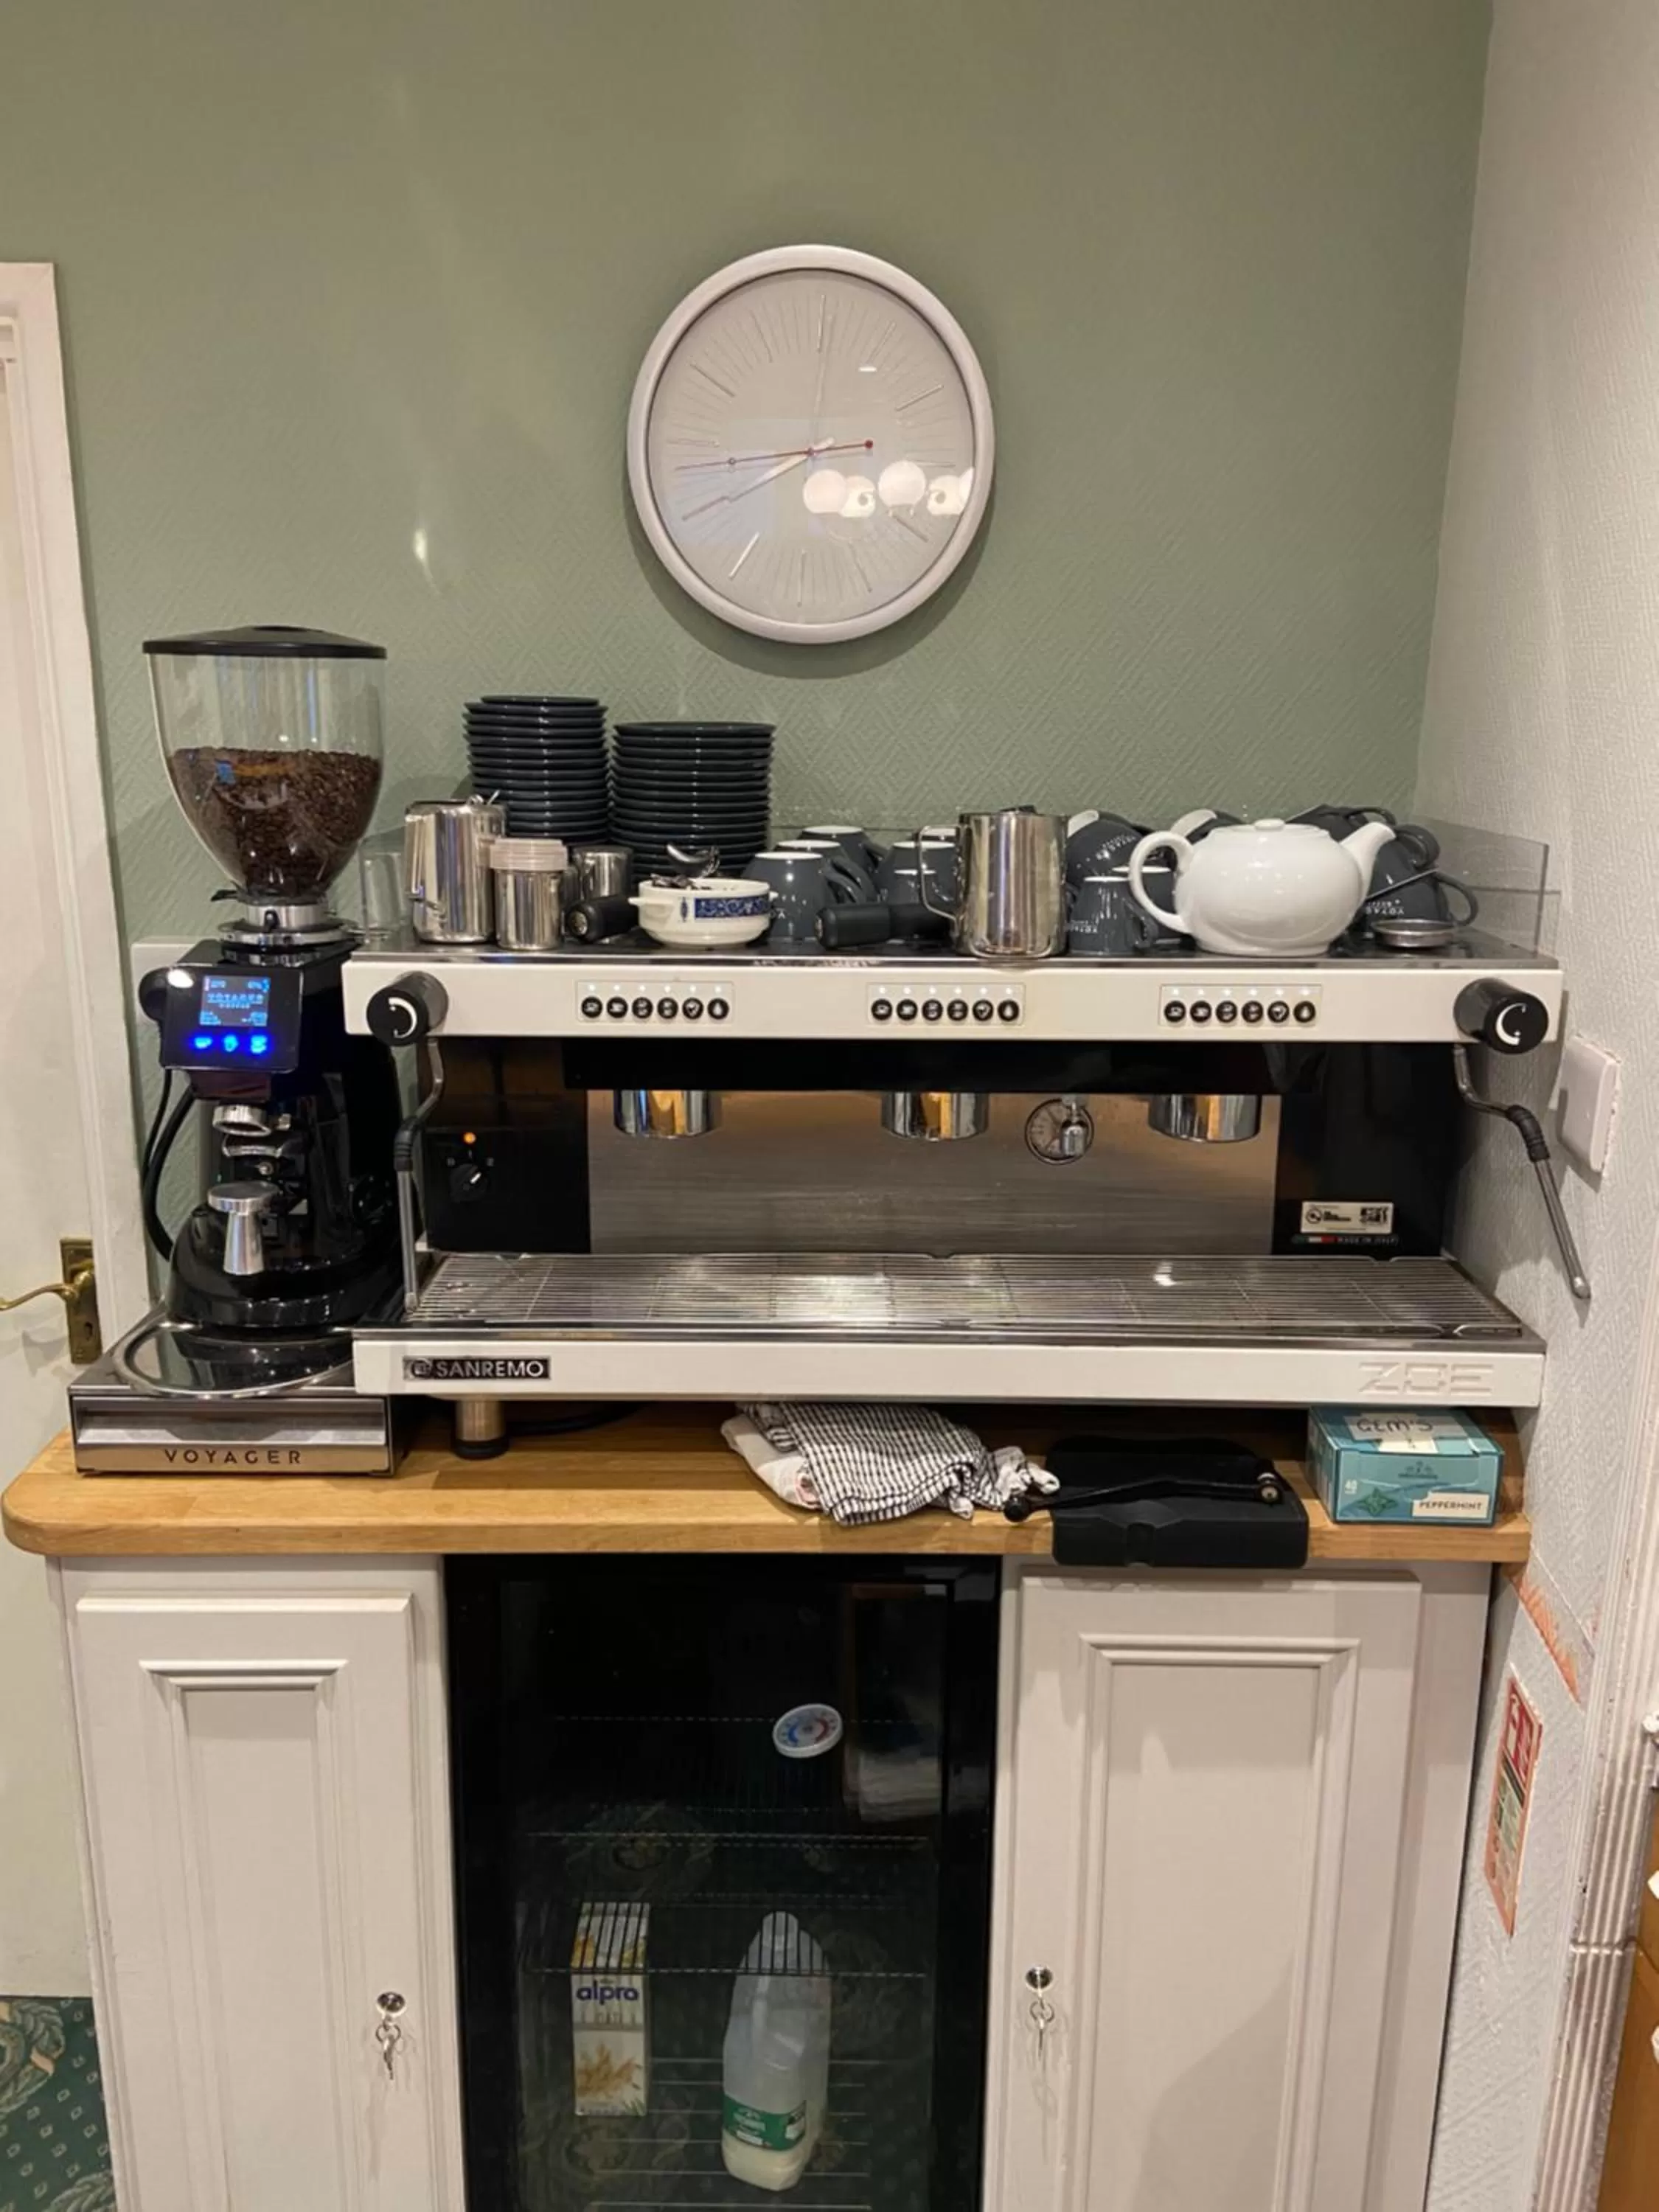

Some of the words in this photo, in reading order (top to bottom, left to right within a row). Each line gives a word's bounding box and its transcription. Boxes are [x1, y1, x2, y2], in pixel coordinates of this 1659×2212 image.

[436, 1360, 544, 1377] SANREMO
[1358, 1362, 1494, 1396] ZOE
[164, 1449, 301, 1464] VOYAGER
[1419, 1500, 1481, 1510] PEPPERMINT
[577, 1980, 639, 2006] alpro
